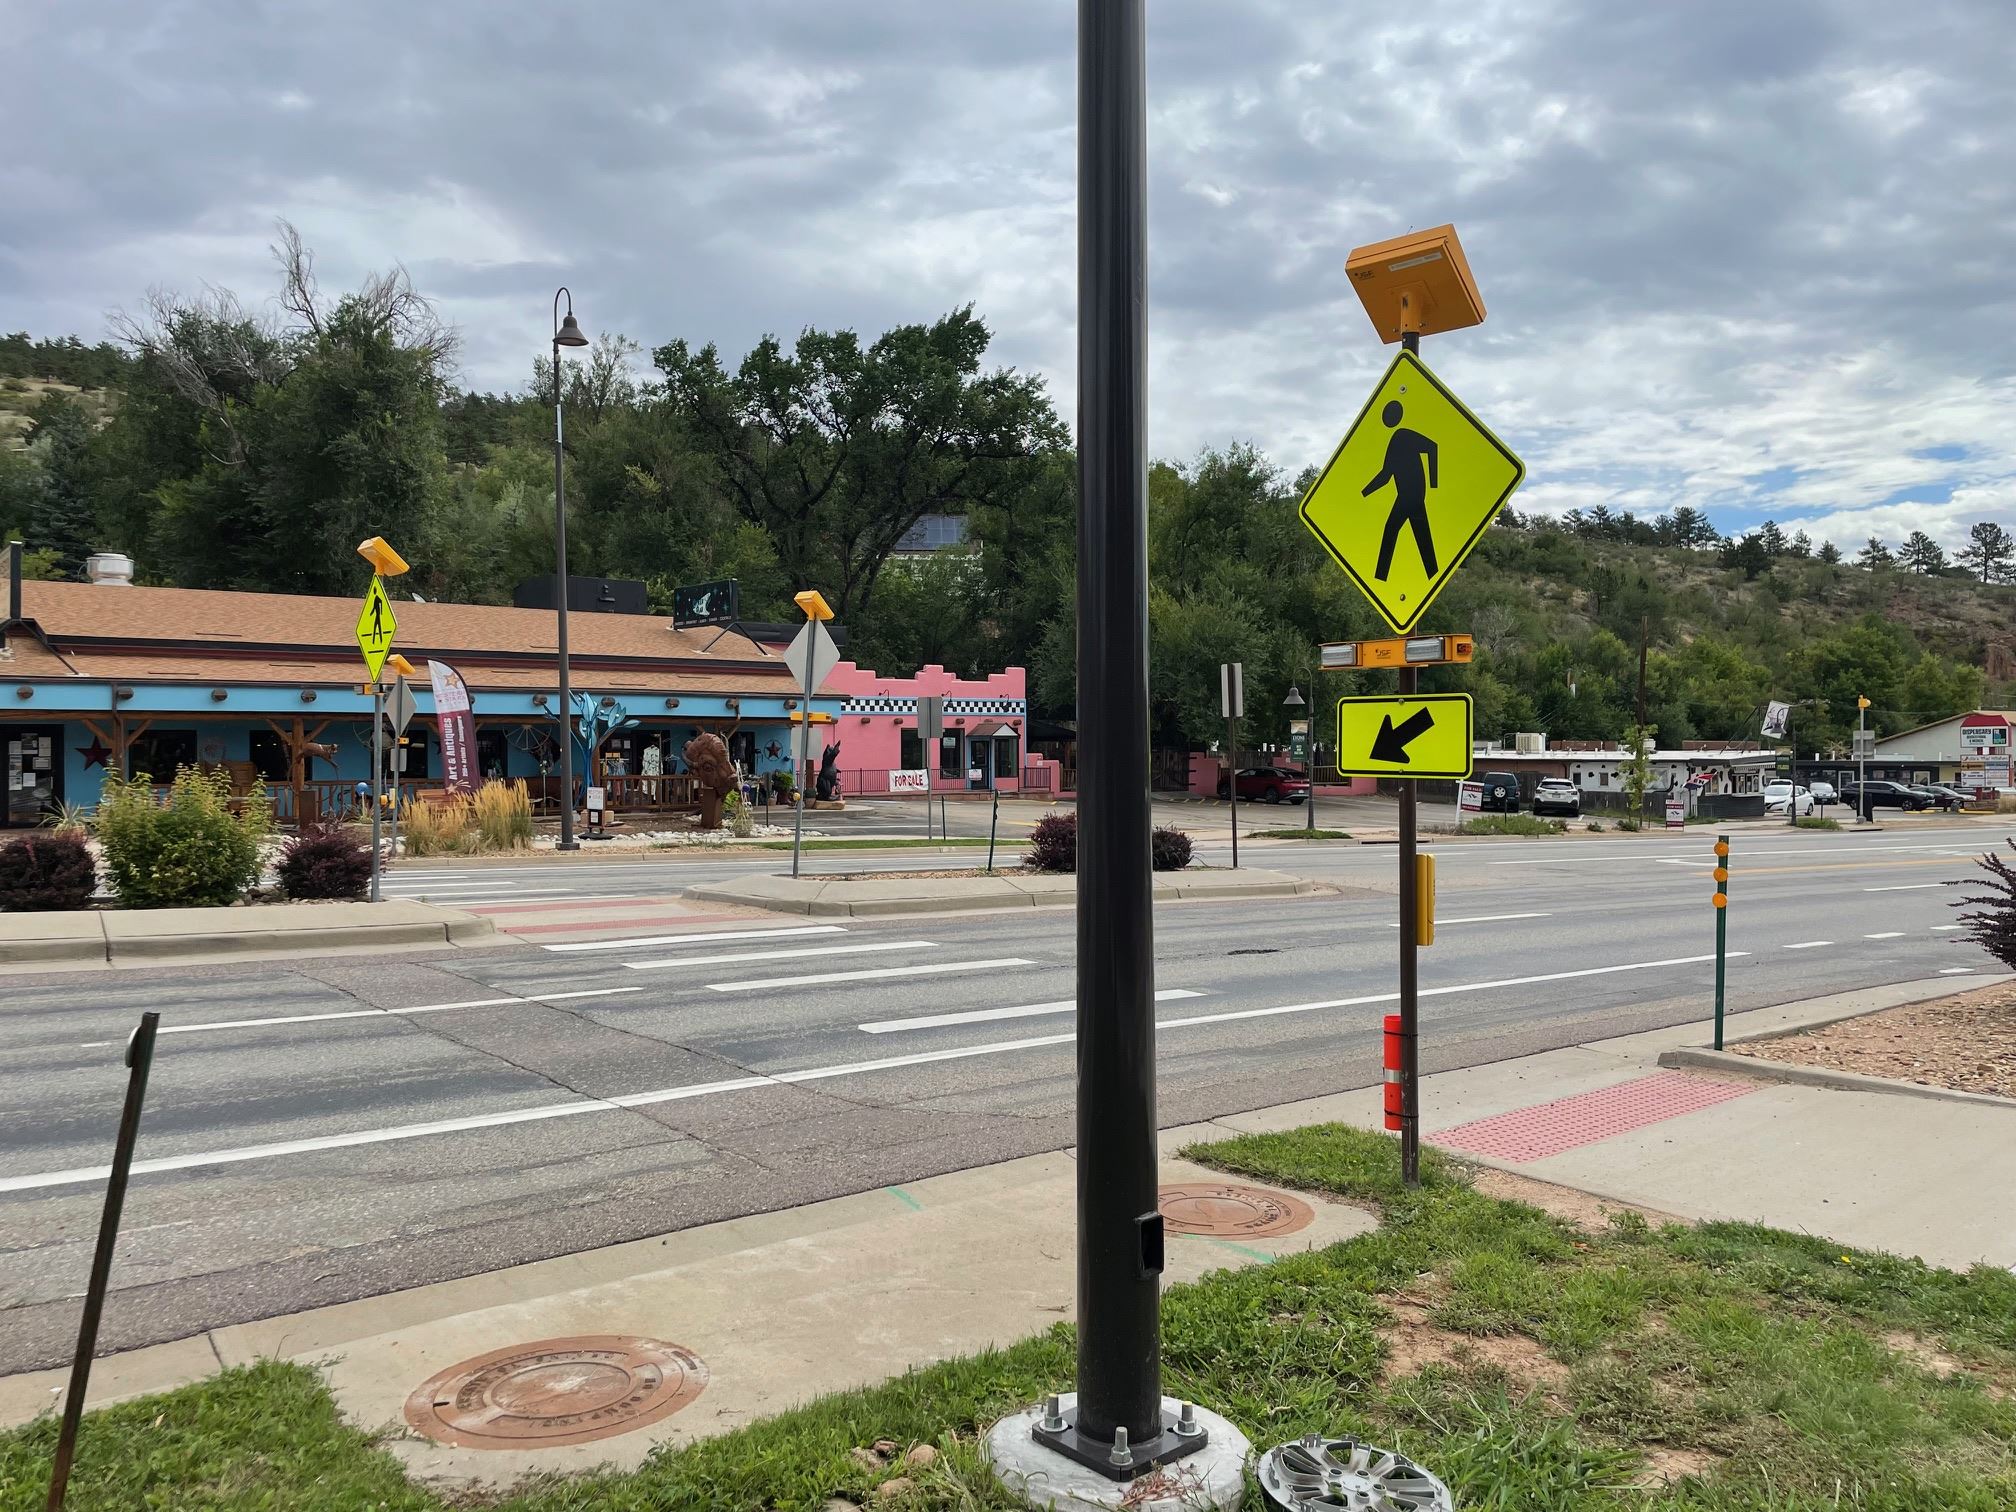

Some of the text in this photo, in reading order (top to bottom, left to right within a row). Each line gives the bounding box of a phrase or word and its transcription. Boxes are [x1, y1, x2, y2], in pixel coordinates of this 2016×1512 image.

[444, 717, 455, 756] Antiques
[448, 766, 457, 780] Art
[895, 775, 923, 787] FOR SALE
